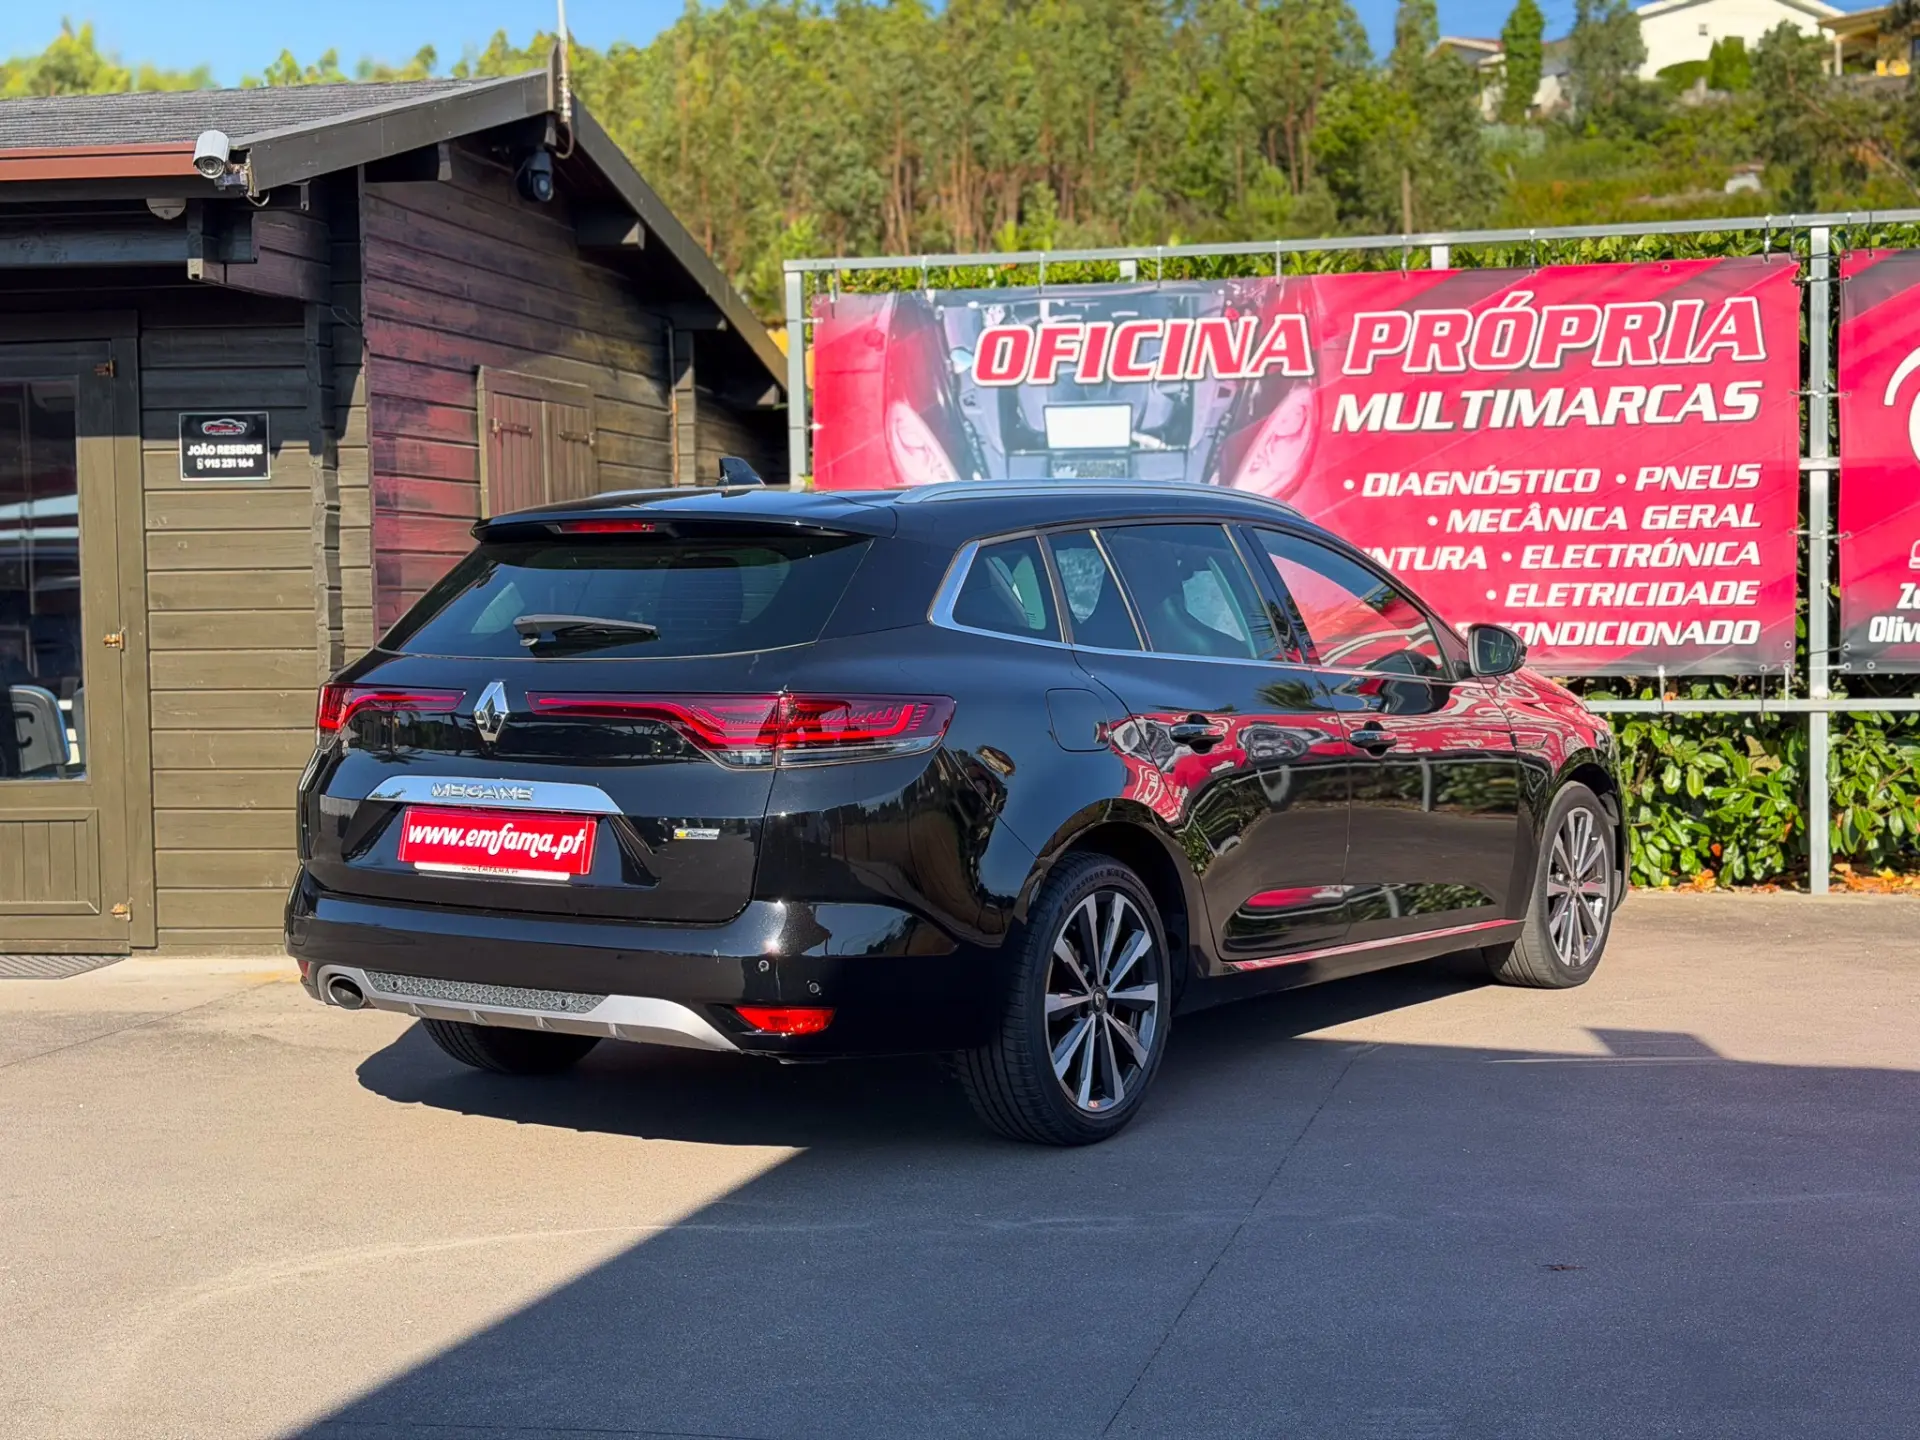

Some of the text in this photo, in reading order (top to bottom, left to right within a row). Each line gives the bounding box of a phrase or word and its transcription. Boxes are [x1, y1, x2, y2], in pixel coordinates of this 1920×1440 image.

[972, 290, 1766, 387] OFICINA PRÓPRIA
[1332, 381, 1764, 432] MULTIMARCAS
[187, 442, 263, 456] JOÃO RESENDE
[1362, 463, 1761, 498] DIAGNÓSTICO PNEUS
[1446, 503, 1761, 533] MECÂNICA GERAL
[1361, 537, 1761, 571] NTURA ELECTRÓNICA
[1504, 580, 1760, 608] ELETRICIDADE
[1497, 621, 1761, 647] ONDICIONADO
[408, 823, 586, 860] www.emfama.pt
